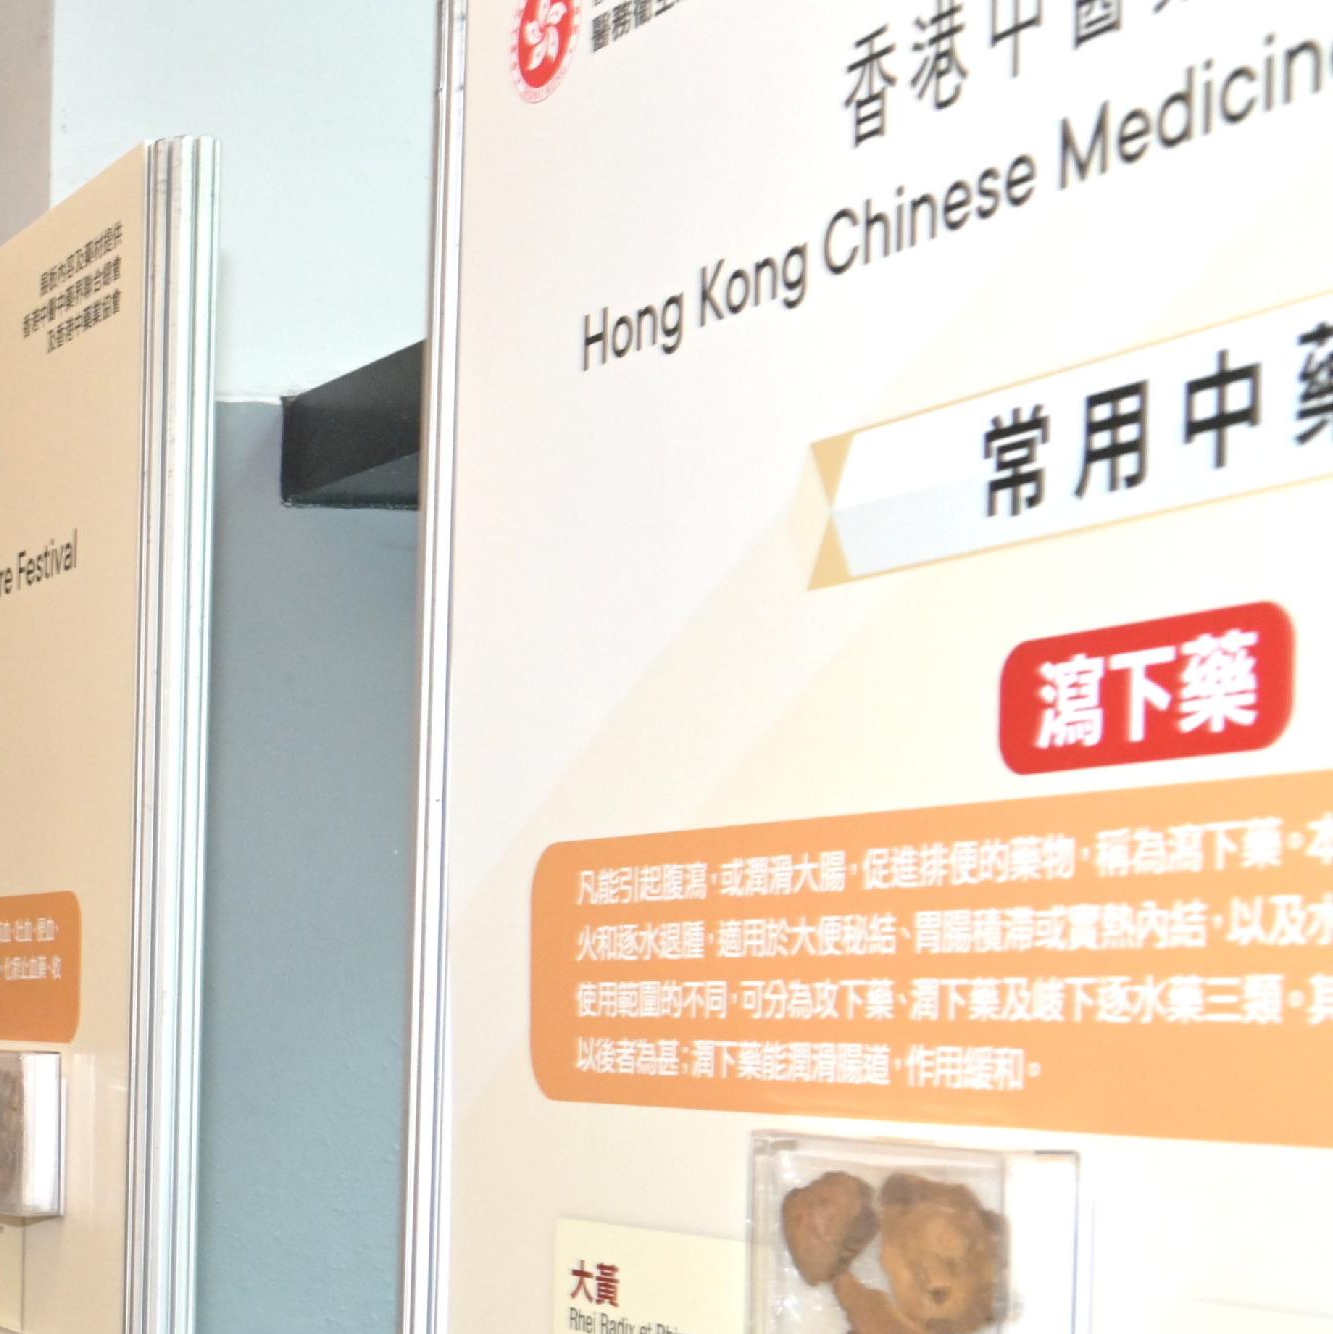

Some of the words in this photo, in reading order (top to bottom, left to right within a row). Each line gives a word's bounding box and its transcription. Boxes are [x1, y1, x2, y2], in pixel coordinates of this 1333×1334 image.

[581, 290, 684, 371] Hong
[699, 240, 809, 328] Kong
[823, 153, 1037, 278] Chinese
[1059, 32, 1333, 191] Medicin
[16, 528, 78, 591] Festival
[1034, 628, 1260, 751] 瀉下藥
[570, 1260, 620, 1308] 大黃
[569, 1307, 596, 1333] Rhei
